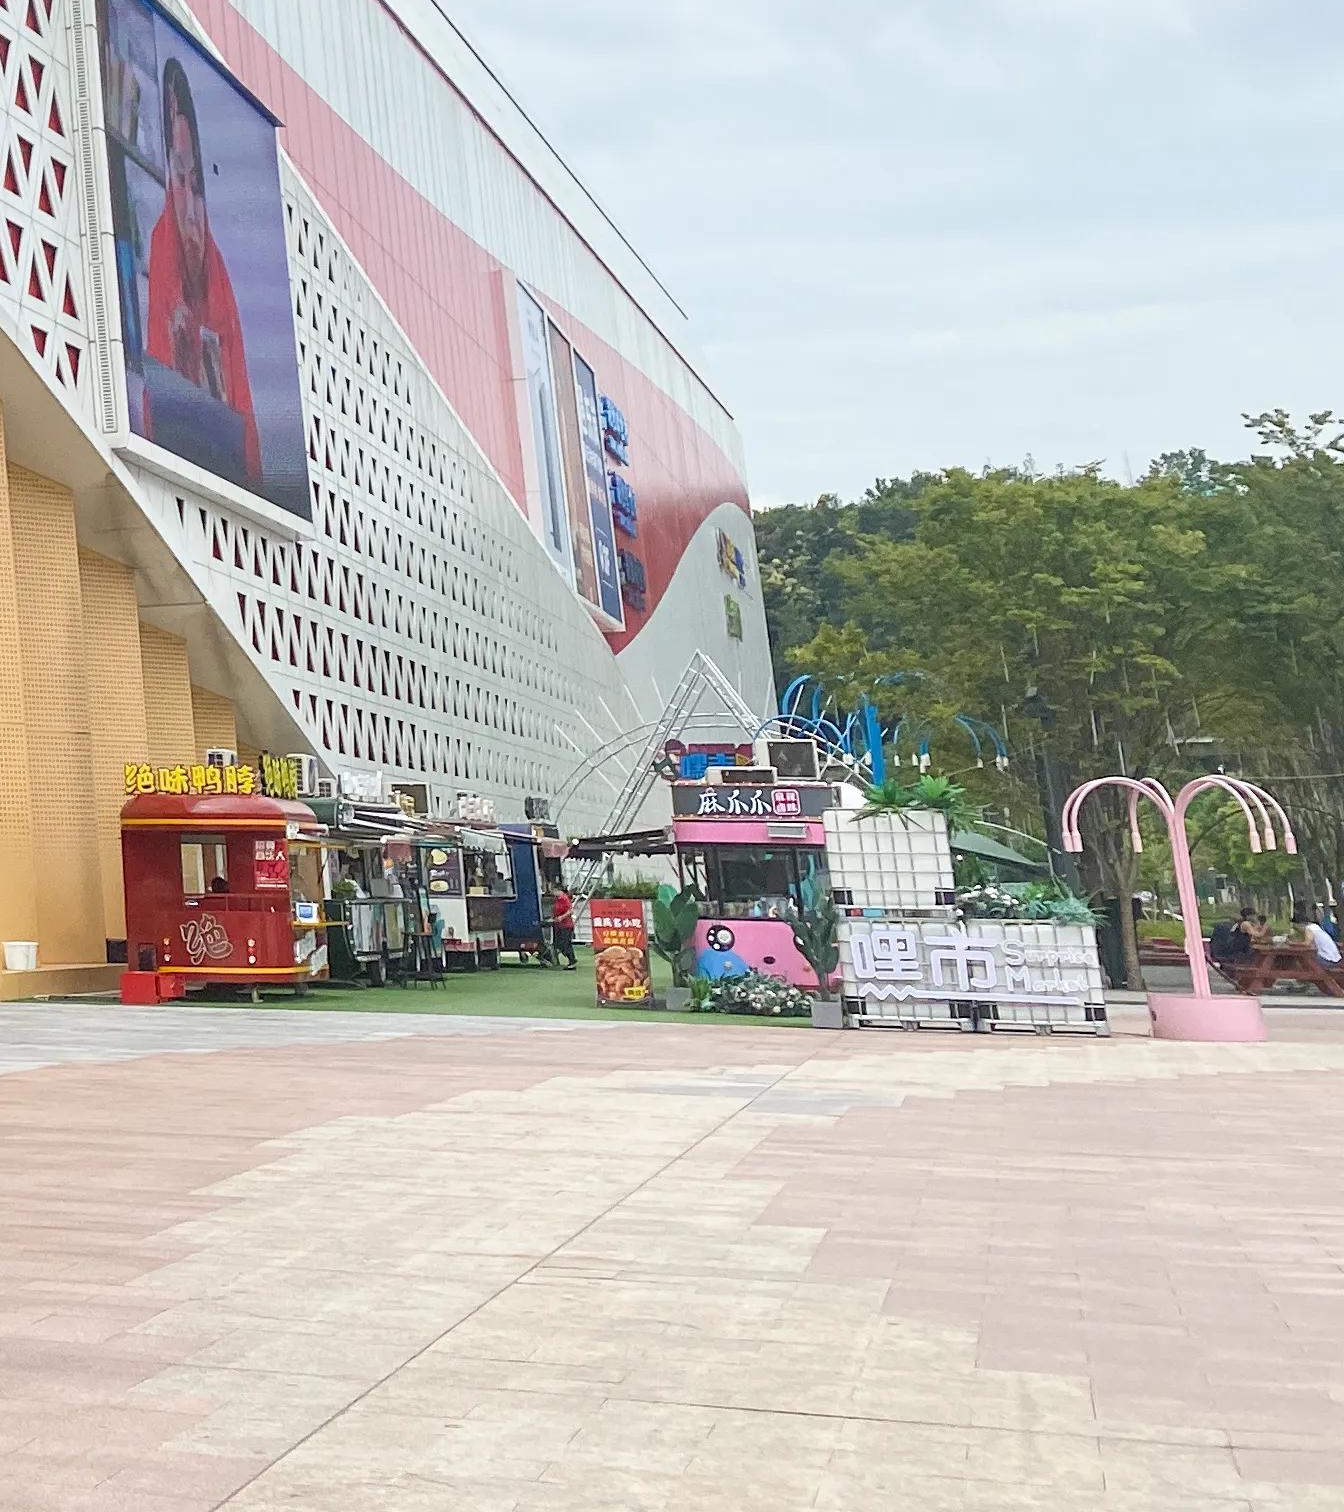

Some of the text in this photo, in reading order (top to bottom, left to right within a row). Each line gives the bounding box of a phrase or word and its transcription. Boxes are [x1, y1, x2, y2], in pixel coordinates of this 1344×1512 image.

[124, 762, 258, 795] 绝味鸭脖
[697, 788, 772, 815] 麻爪爪
